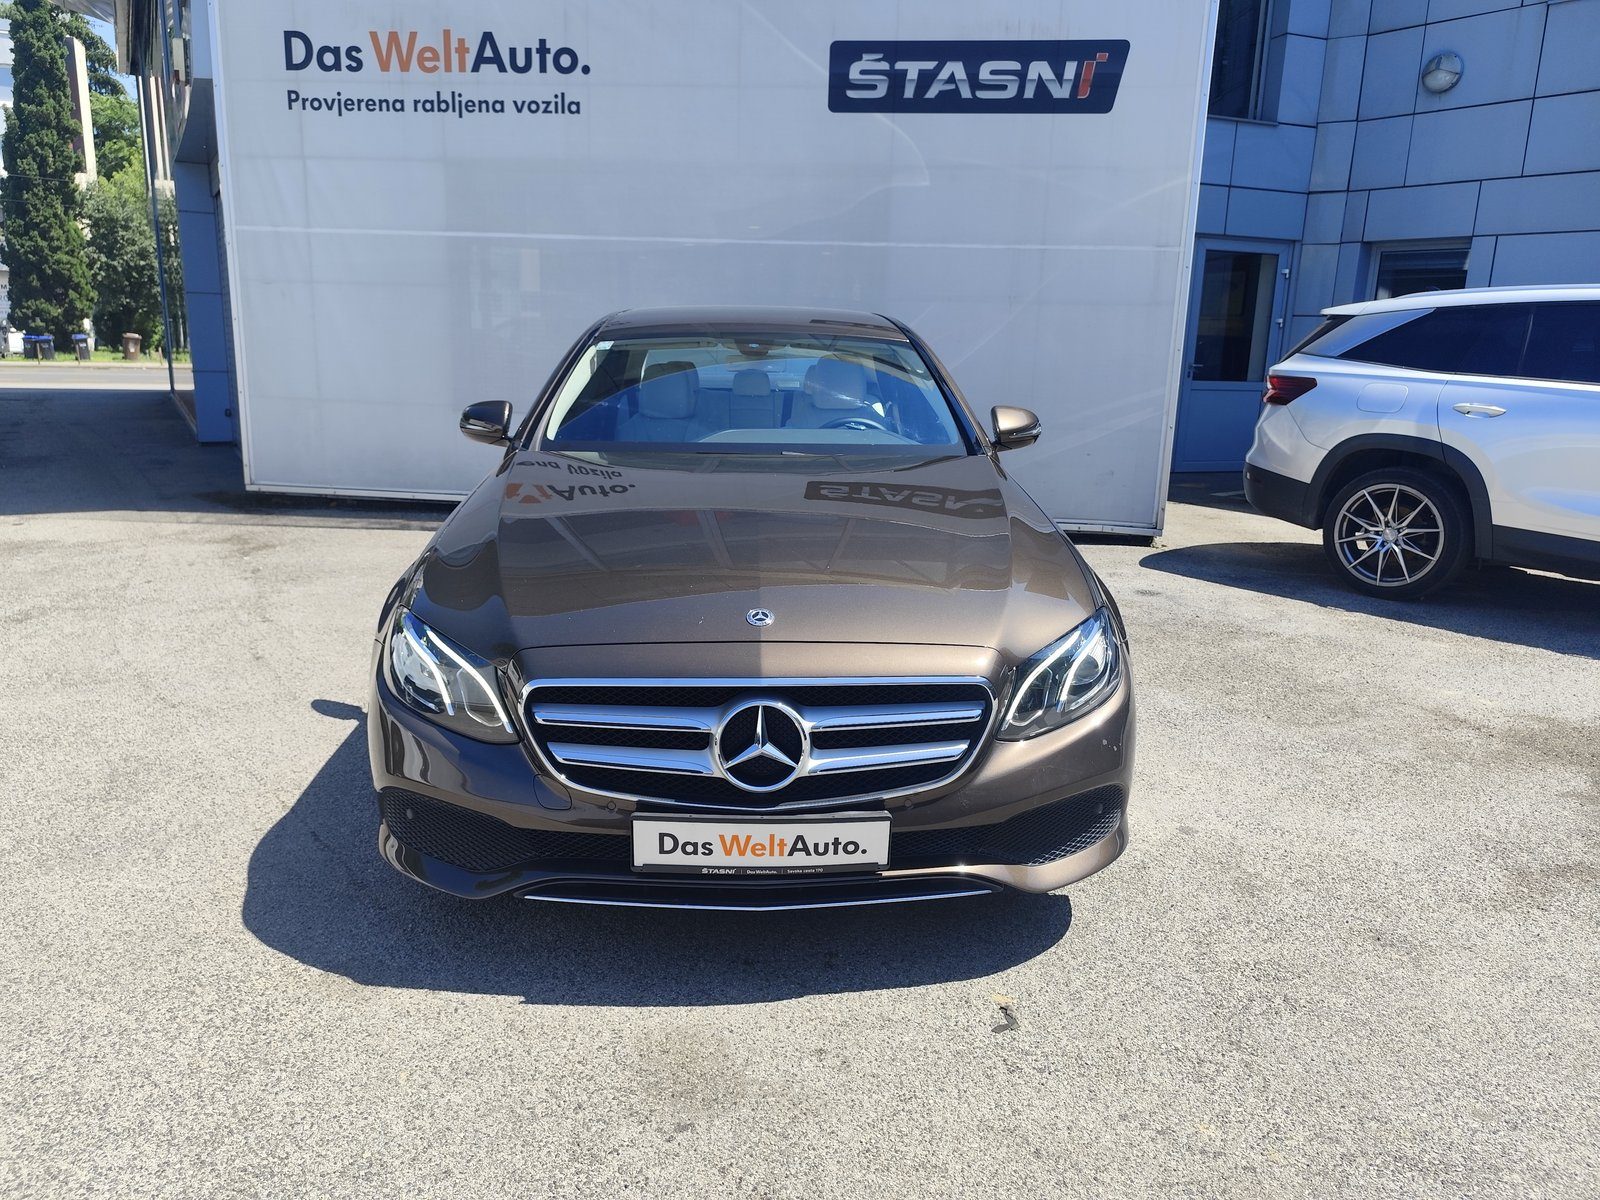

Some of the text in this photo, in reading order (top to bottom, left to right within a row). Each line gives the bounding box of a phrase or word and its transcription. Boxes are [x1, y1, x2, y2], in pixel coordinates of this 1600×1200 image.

[283, 29, 591, 75] Das WeltAuto.
[287, 89, 581, 118] Provjerena rabljena vozila
[658, 832, 868, 858] Das WeltAuto.
